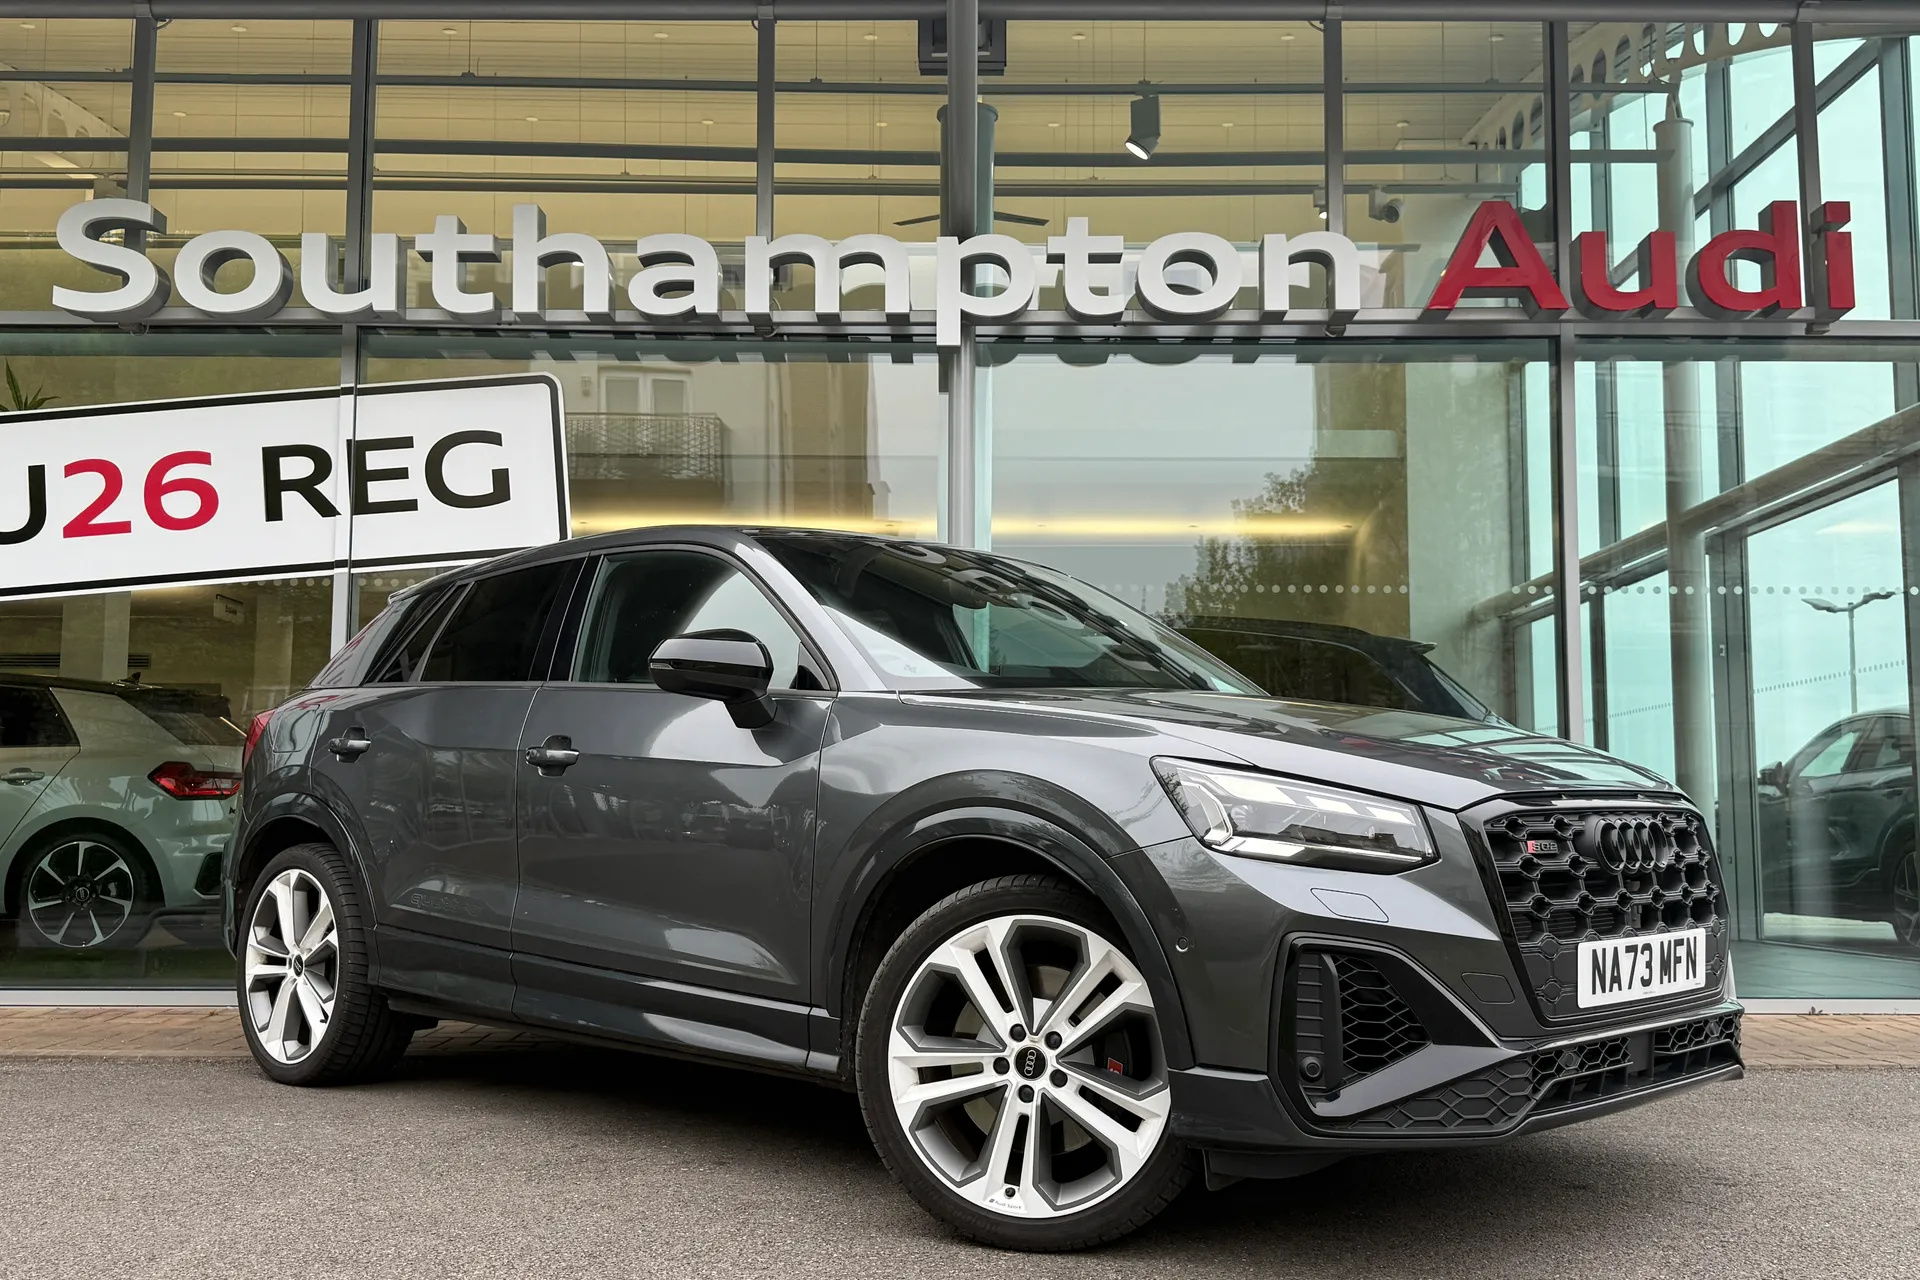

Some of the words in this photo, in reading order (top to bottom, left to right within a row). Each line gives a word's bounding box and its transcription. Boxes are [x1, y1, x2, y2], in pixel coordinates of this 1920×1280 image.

[50, 199, 1363, 348] Southampton
[1423, 200, 1858, 325] Audi
[262, 429, 512, 523] REG
[1591, 942, 1653, 995] NA73
[1659, 936, 1697, 985] MFN
